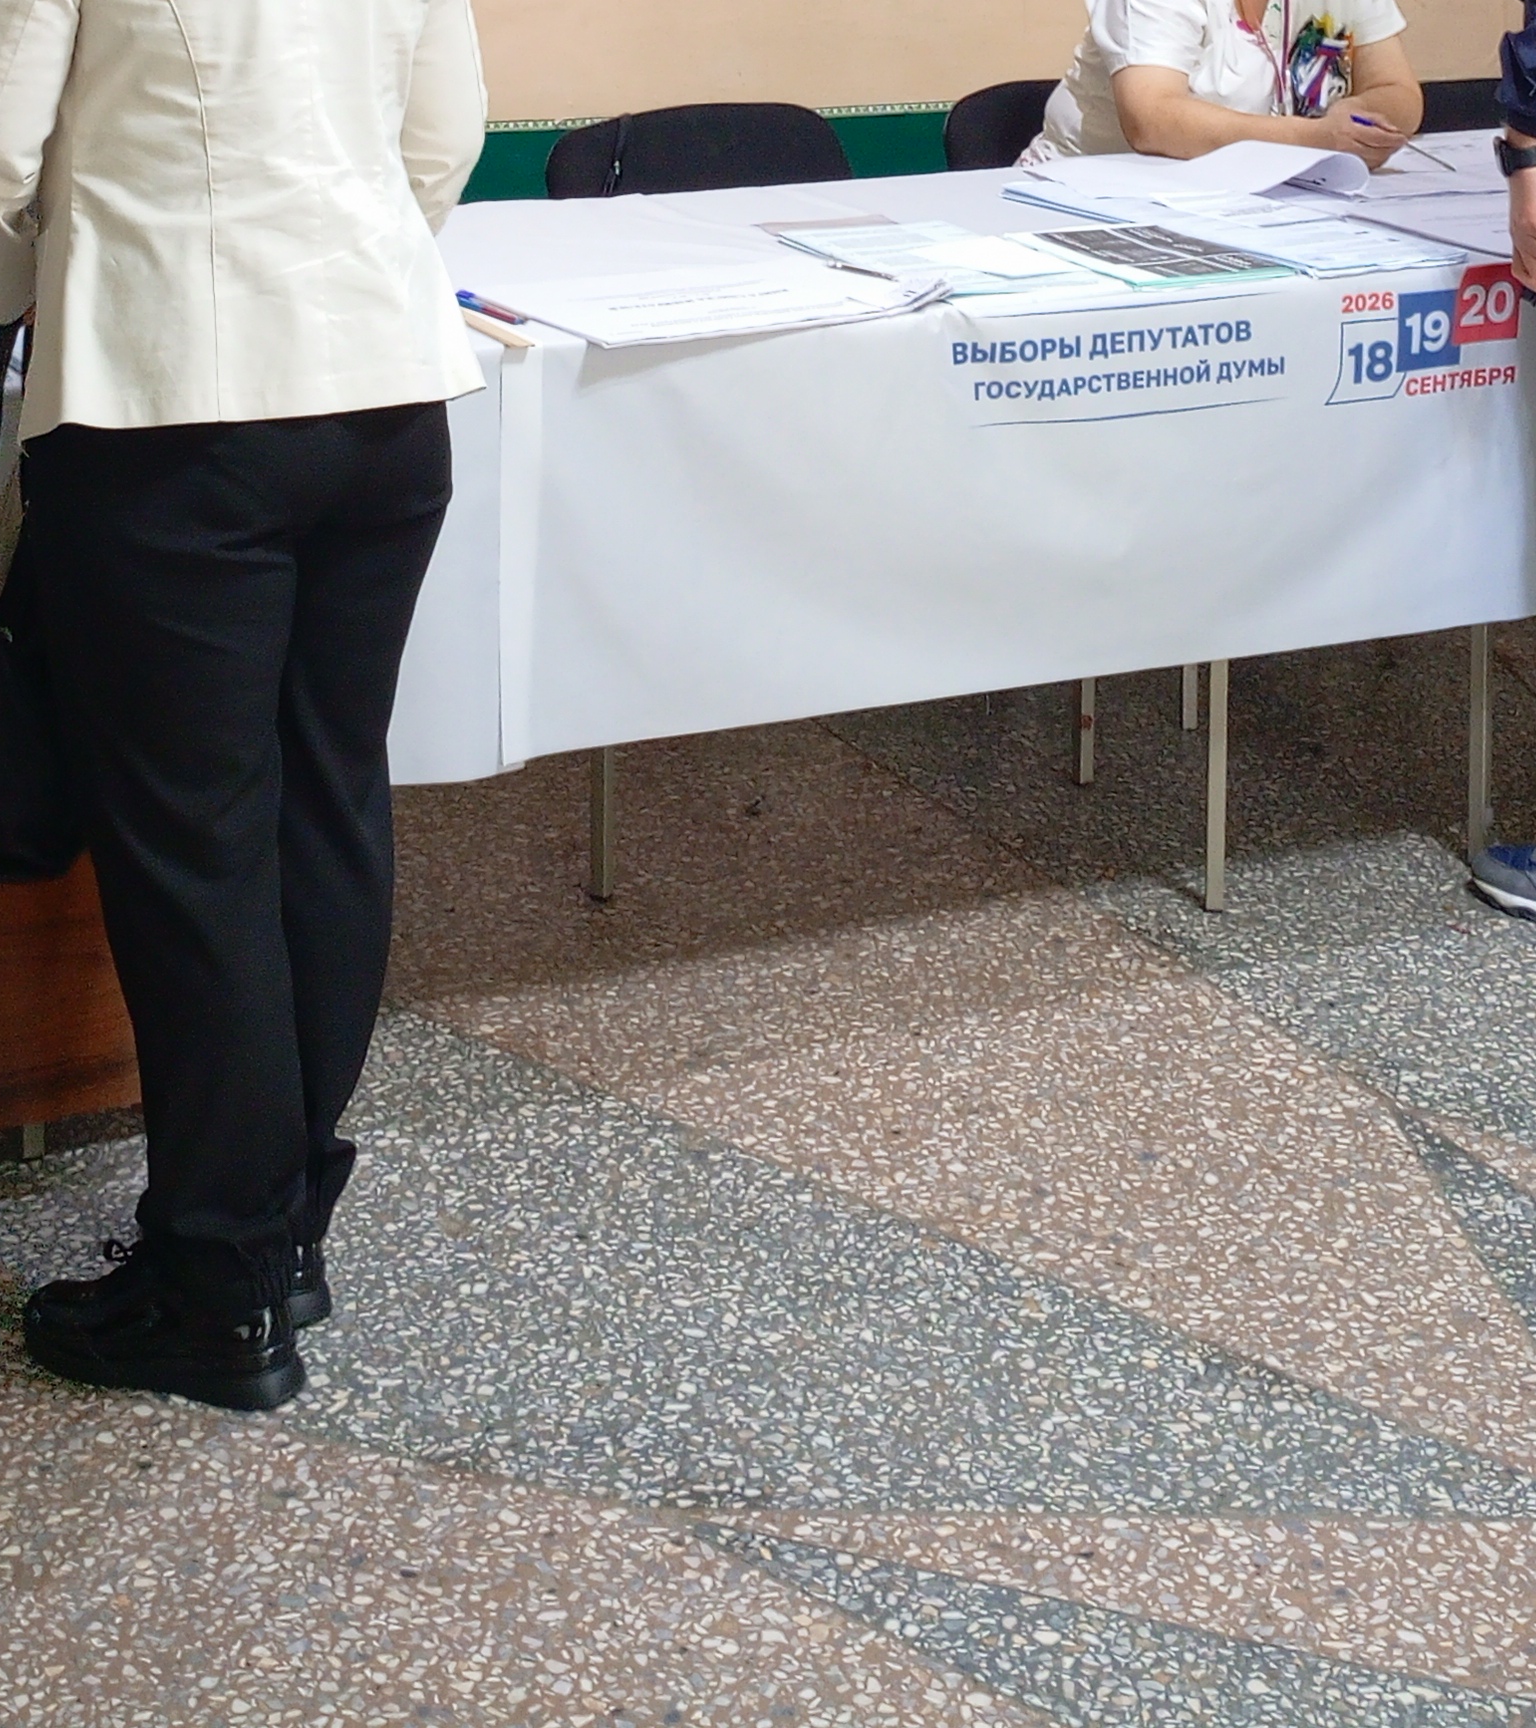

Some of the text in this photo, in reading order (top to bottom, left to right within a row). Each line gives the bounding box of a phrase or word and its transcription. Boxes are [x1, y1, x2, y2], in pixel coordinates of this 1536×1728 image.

[1341, 291, 1394, 314] 2026
[951, 319, 1252, 367] ВЫБОРЫ ДЕПУТАТОВ
[1348, 283, 1512, 384] 18 19 20
[974, 356, 1286, 402] ГОСУДАРСТВЕННОЙ ДУМЫ
[1404, 365, 1516, 397] СЕНТЯБРЯ
